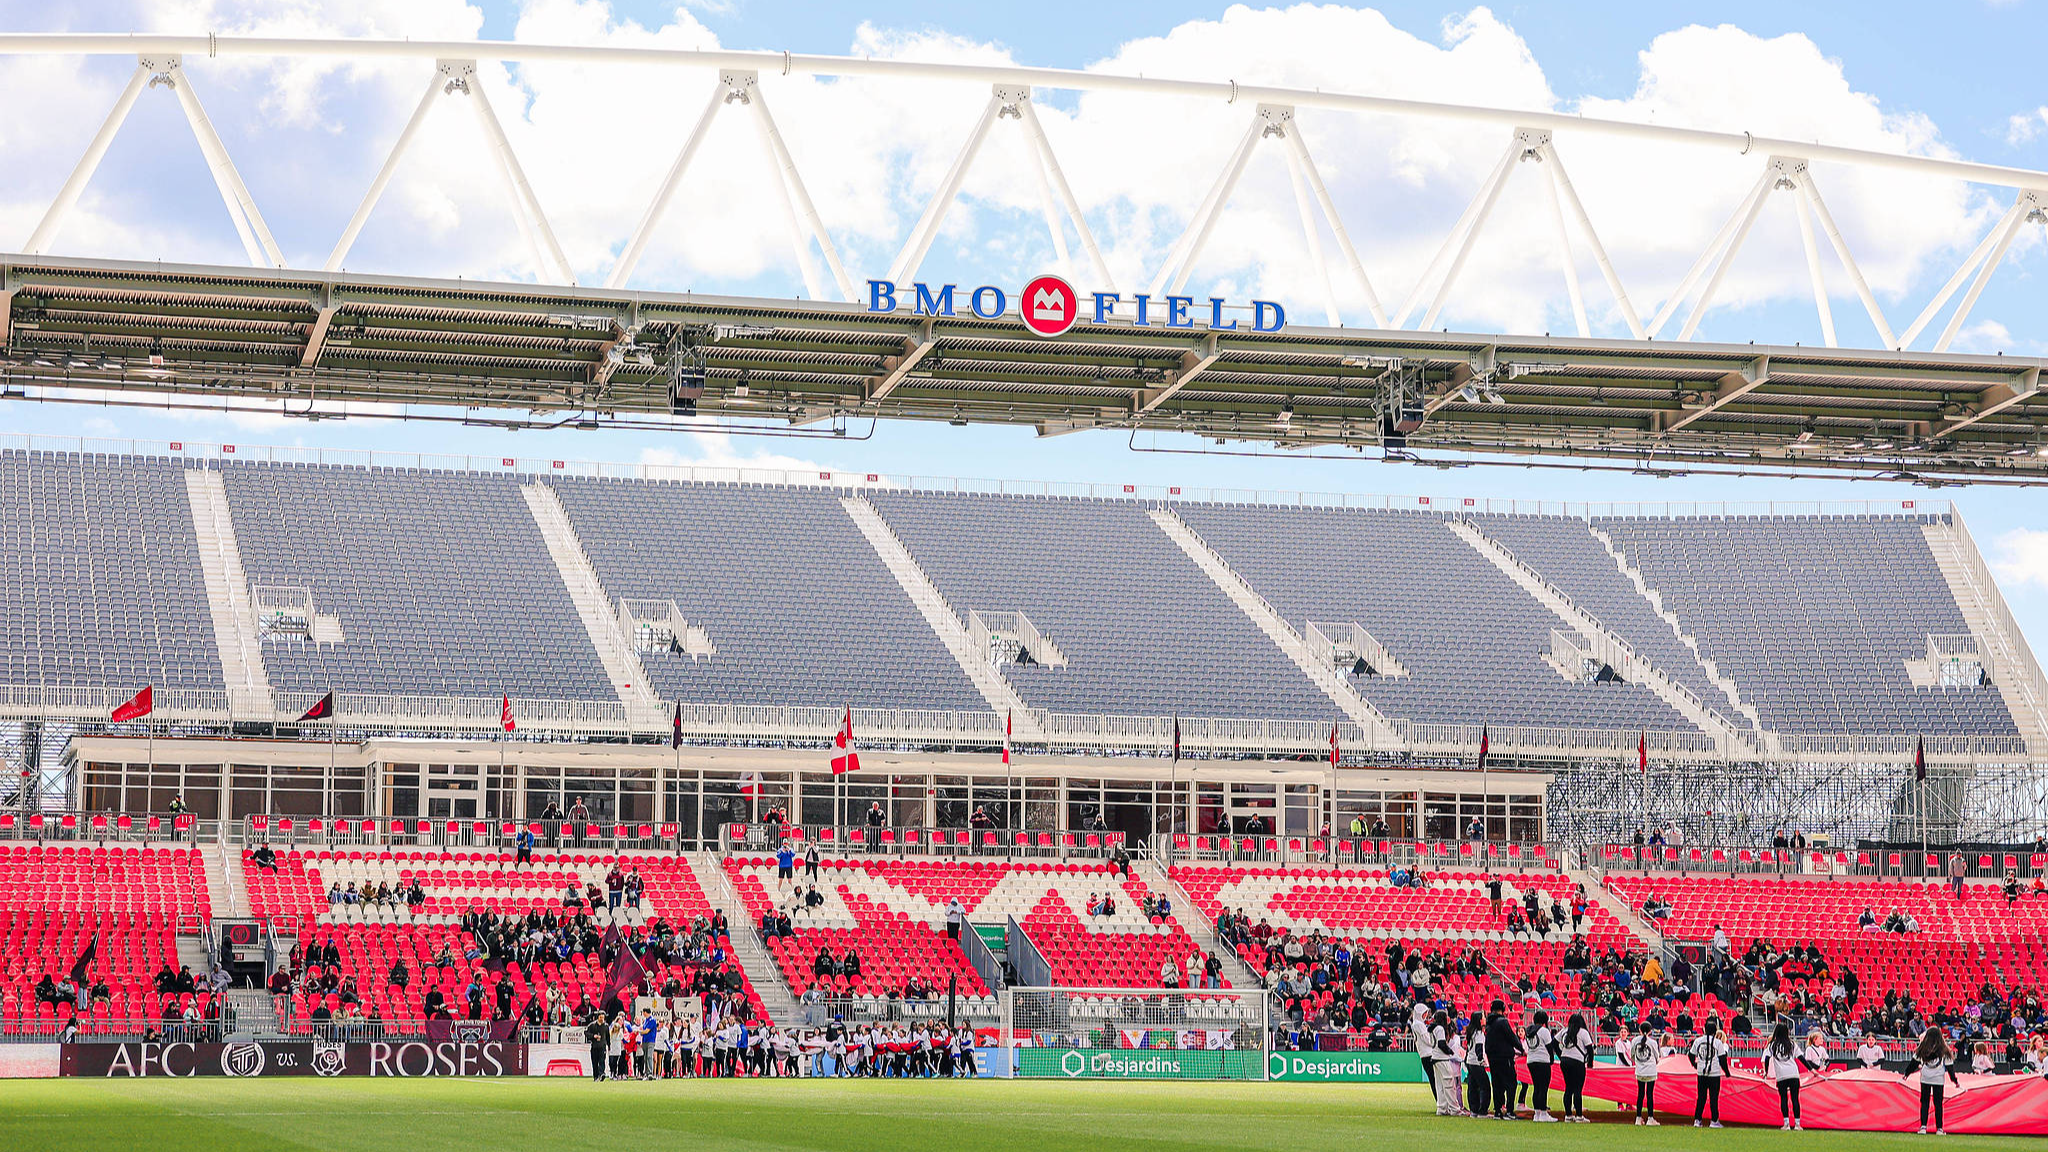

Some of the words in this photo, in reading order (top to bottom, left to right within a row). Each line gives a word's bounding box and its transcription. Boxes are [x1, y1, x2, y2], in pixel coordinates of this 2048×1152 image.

[866, 279, 1007, 319] BMO
[1091, 291, 1287, 333] FIELD
[181, 815, 193, 824] 113
[254, 816, 266, 824] 114
[664, 824, 675, 833] 114
[732, 825, 744, 833] 115
[1111, 833, 1122, 841] 115
[1175, 834, 1186, 842] 116
[1607, 844, 1617, 852] 117
[2035, 854, 2046, 862] 117
[1546, 860, 1558, 868] 116
[106, 1043, 196, 1077] AFC
[369, 1042, 503, 1076] ROSES
[1292, 1058, 1382, 1078] Desjardins
